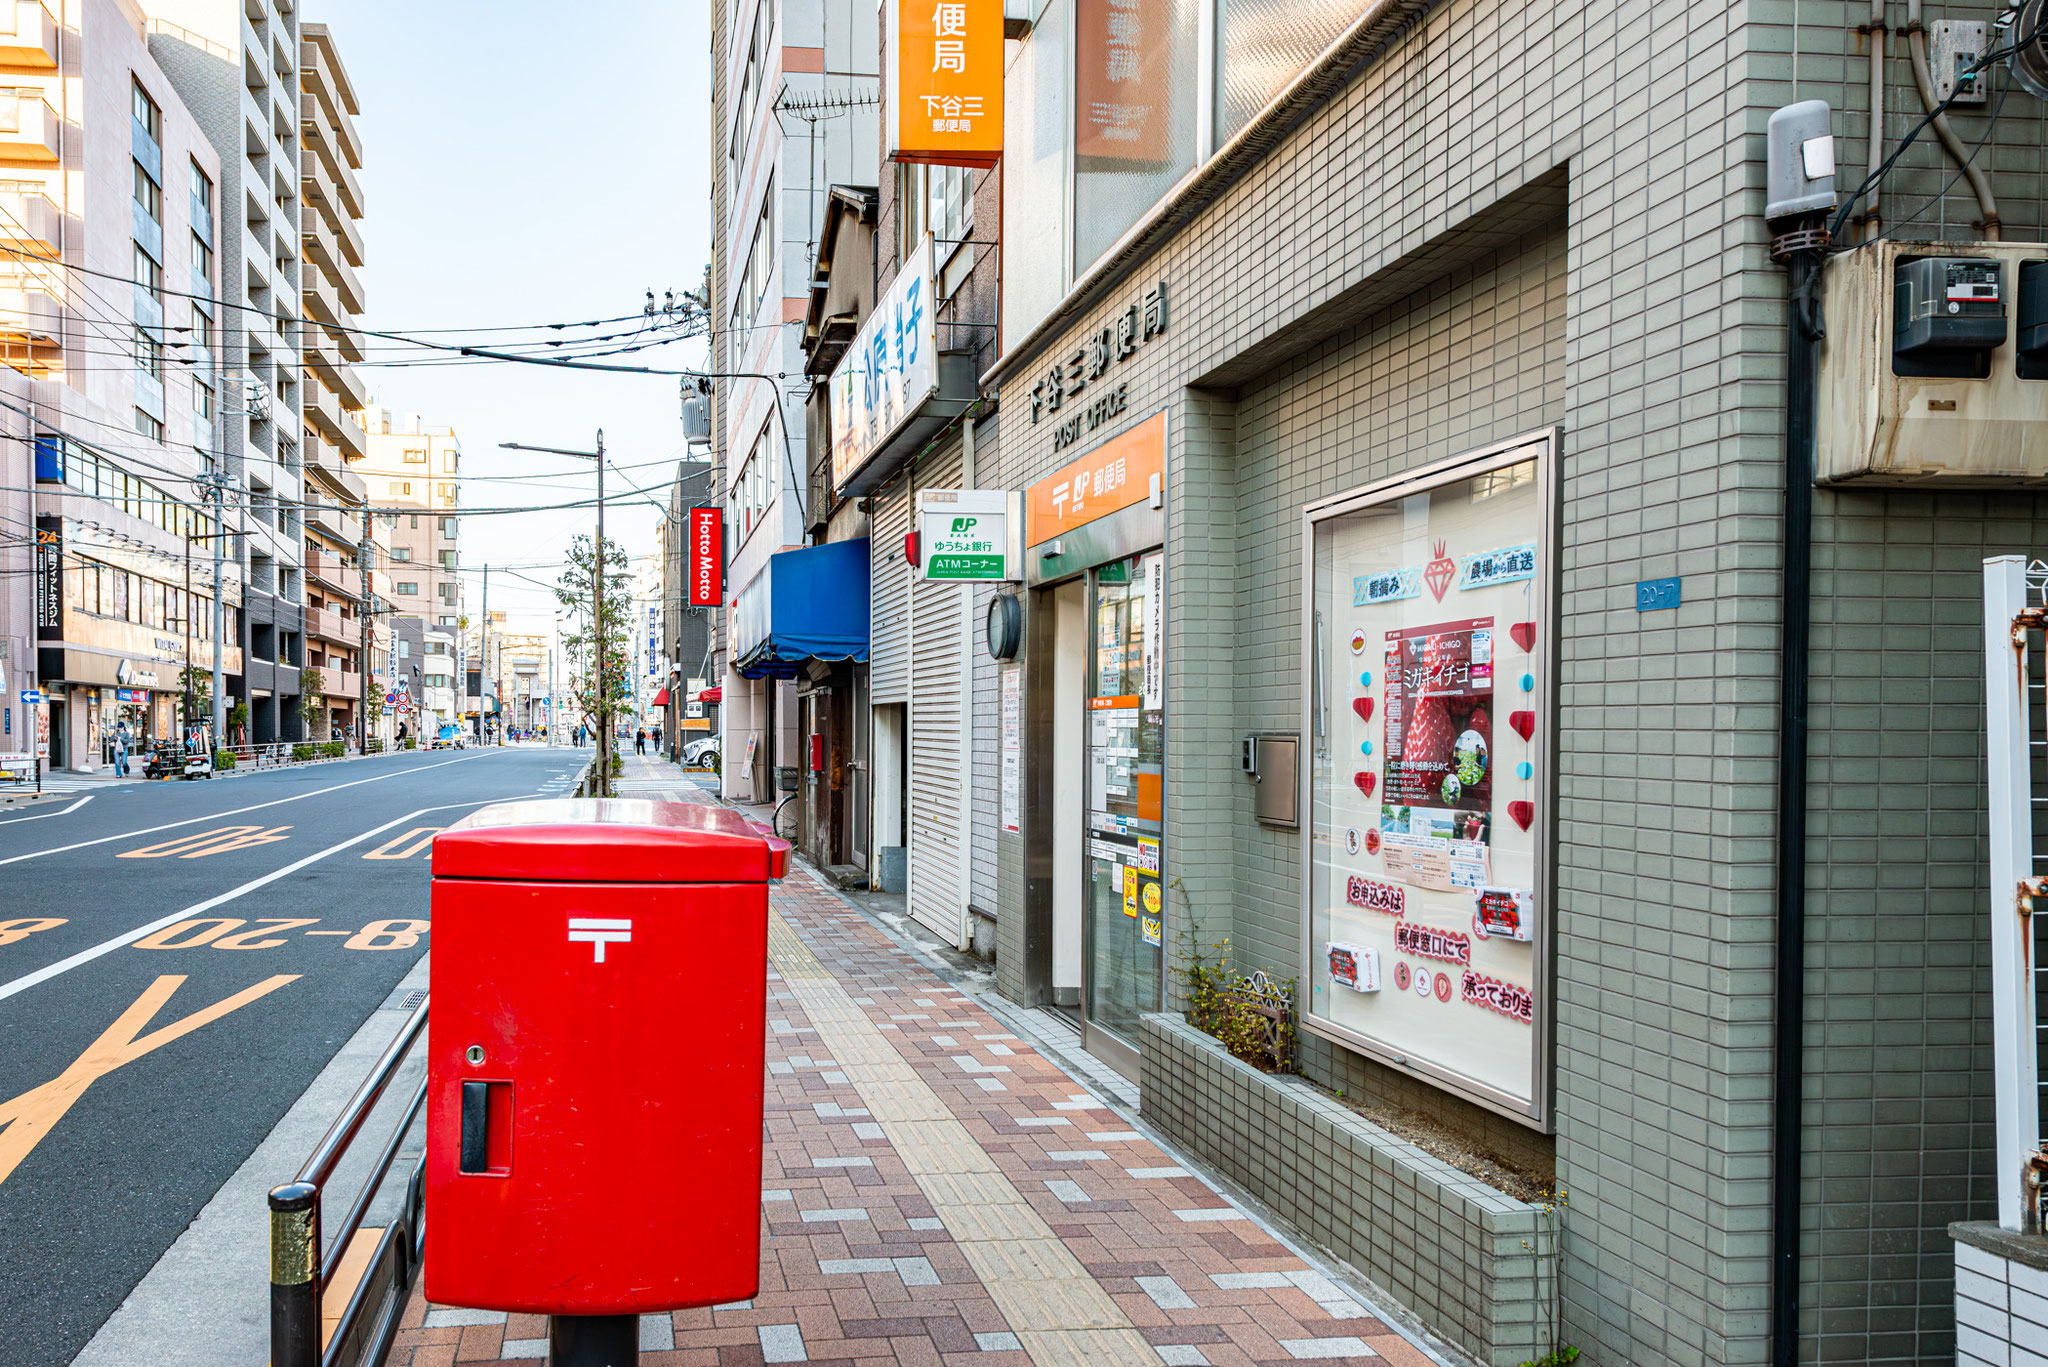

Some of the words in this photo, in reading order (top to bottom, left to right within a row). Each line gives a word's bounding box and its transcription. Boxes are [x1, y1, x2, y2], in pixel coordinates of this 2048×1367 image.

[920, 95, 984, 117] 下谷三
[932, 119, 971, 132] 郵便局
[1026, 281, 1168, 425] 下谷三郵便局
[1053, 412, 1082, 453] POST
[1087, 382, 1129, 432] OFFICE
[1093, 457, 1126, 498] 郵便局
[38, 530, 57, 544] 24
[699, 513, 713, 555] Hotto
[951, 517, 977, 533] JP
[934, 541, 992, 552] ゆうちょ銀行
[699, 556, 713, 600] Motto
[1470, 551, 1534, 581] 農場から直送
[1368, 575, 1400, 599] 朝摘み
[1641, 583, 1675, 604] 20-7
[1403, 662, 1470, 688] ミガキイチゴ
[115, 825, 296, 858] 40
[1351, 882, 1402, 911] お申込みは
[131, 918, 431, 950] 8-20
[1397, 927, 1468, 961] 郵便窓口にて
[1462, 975, 1533, 1017] 承っておりま
